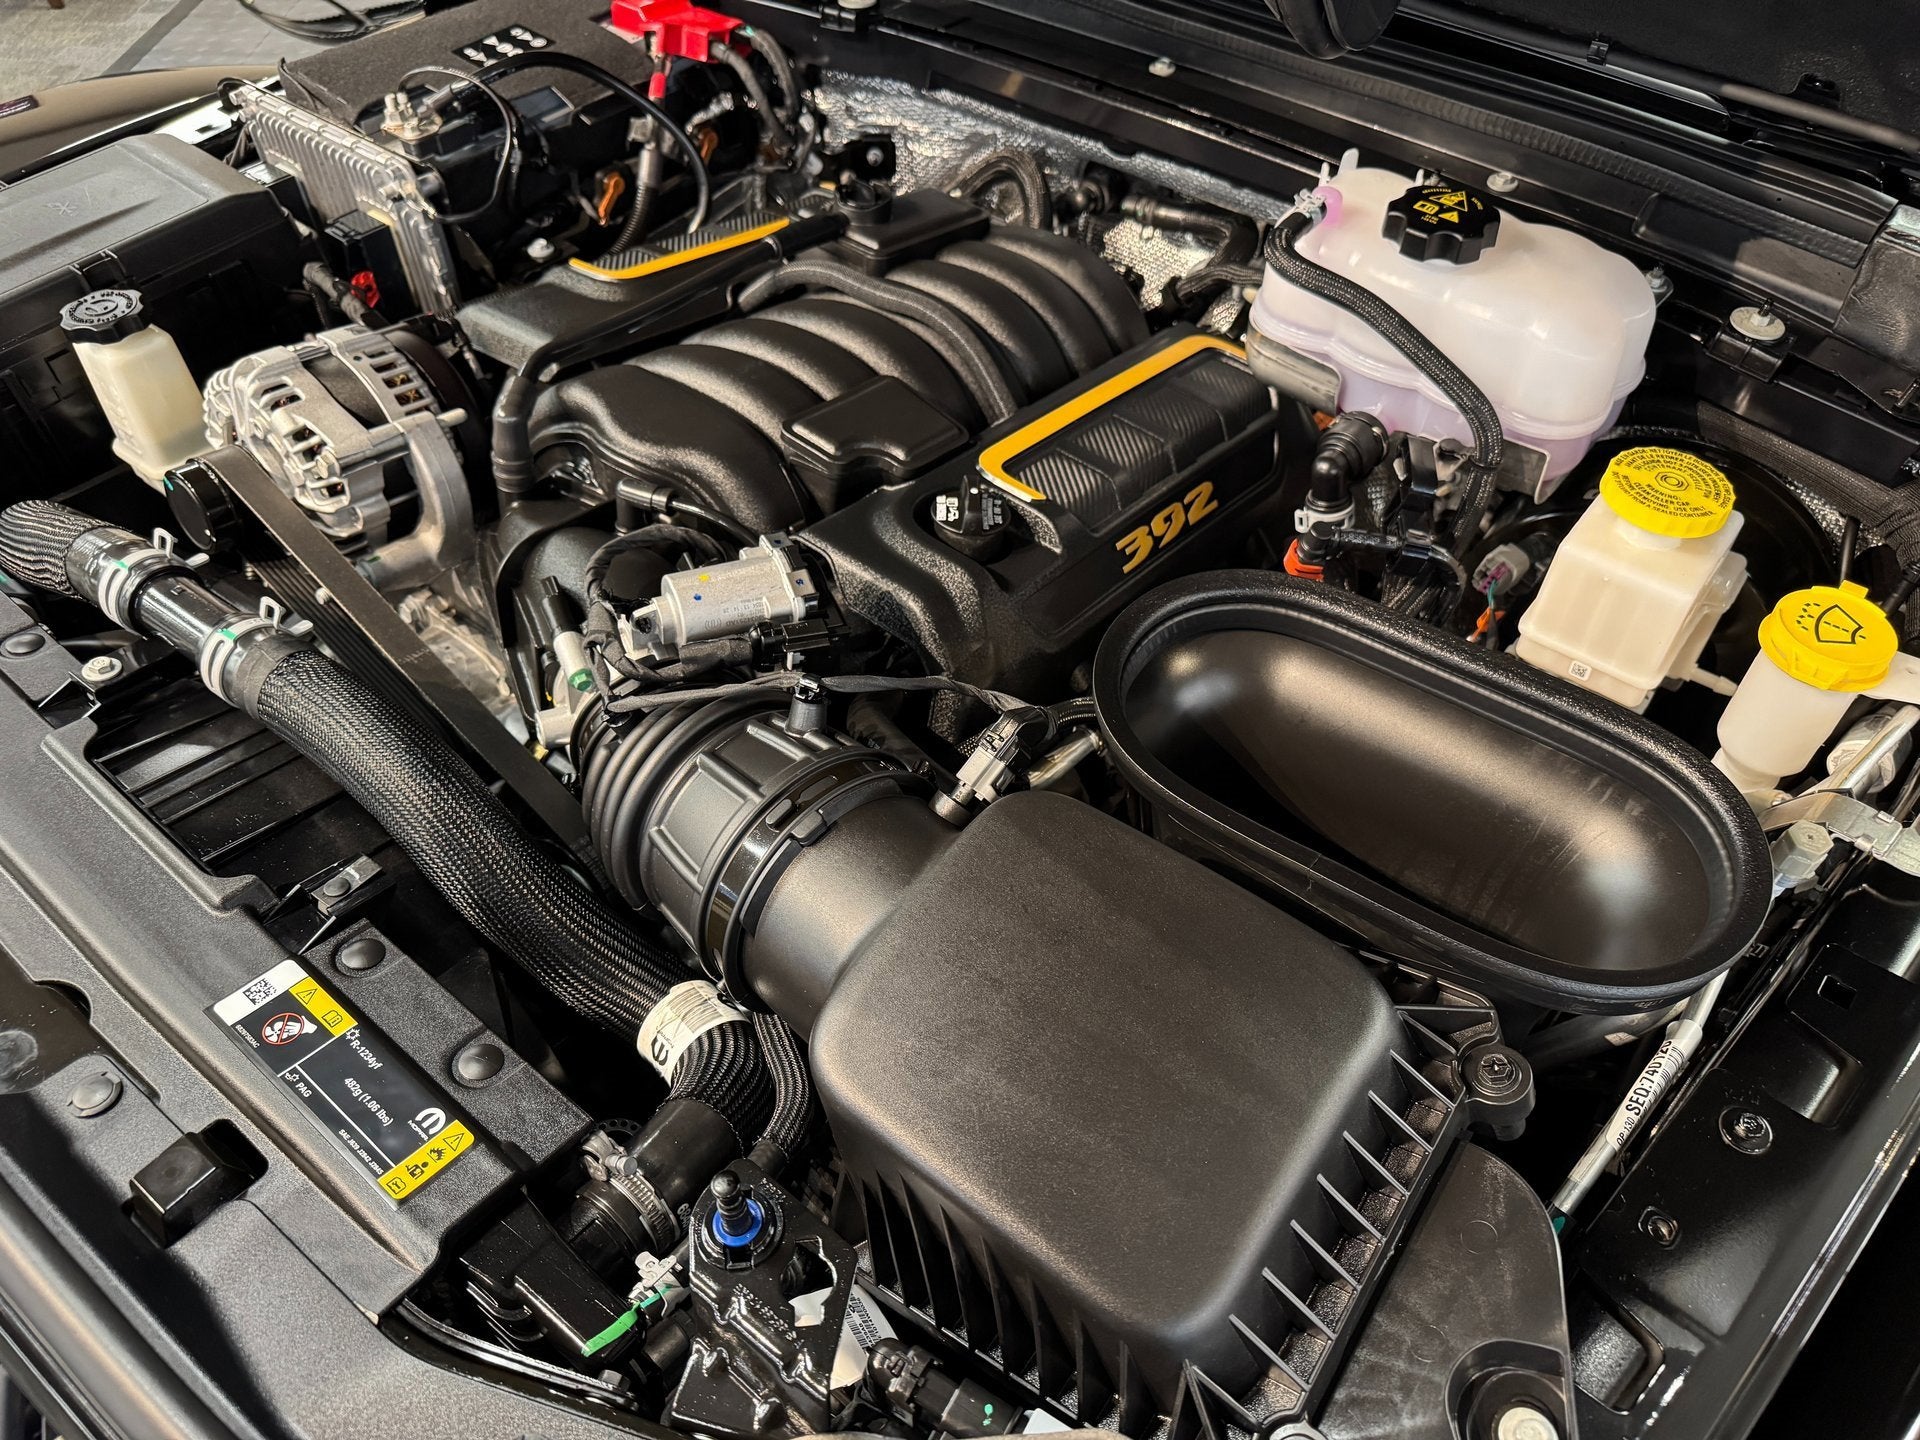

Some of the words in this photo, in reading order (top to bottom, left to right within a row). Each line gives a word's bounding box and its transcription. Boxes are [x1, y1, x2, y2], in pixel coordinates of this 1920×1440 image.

[1634, 481, 1651, 498] CLEAN
[1651, 493, 1675, 507] FILLER
[1645, 483, 1681, 500] WARNING:
[1652, 506, 1679, 517] SEALED
[1115, 481, 1219, 575] 392
[349, 1040, 384, 1069] R-1234yf
[295, 1082, 312, 1098] PAG
[344, 1078, 363, 1097] 482g
[358, 1093, 380, 1112] (1.06
[376, 1108, 394, 1127] lbs)
[338, 1129, 350, 1141] SAE
